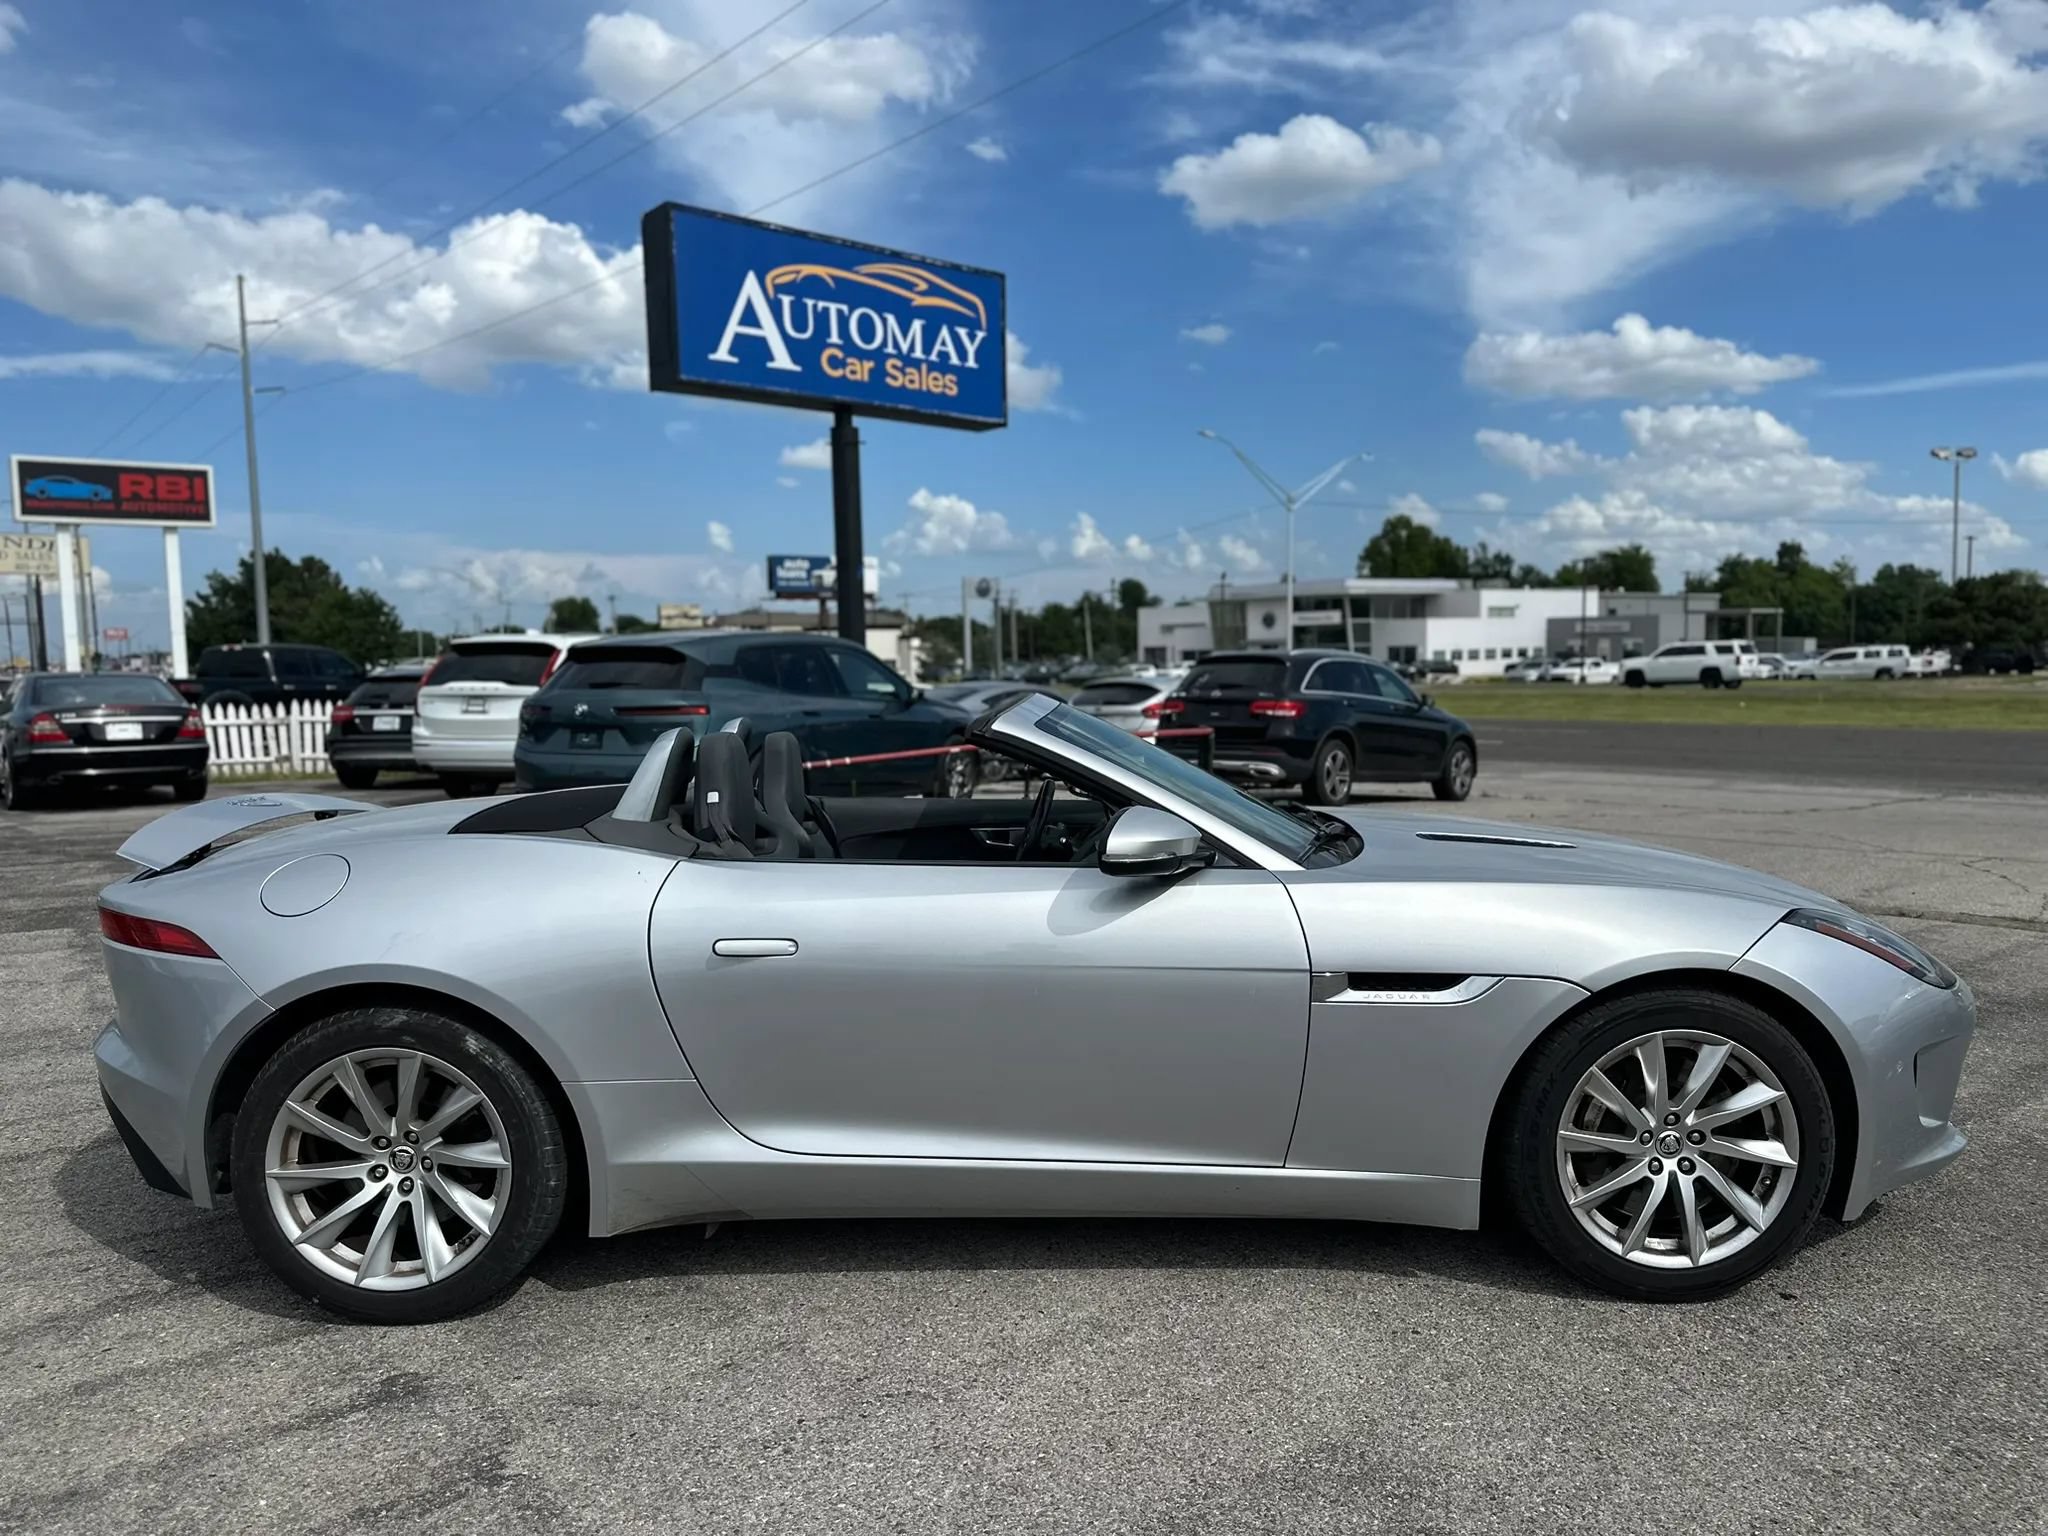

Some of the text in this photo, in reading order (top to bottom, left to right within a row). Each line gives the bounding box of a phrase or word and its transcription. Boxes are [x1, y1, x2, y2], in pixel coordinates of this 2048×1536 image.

[707, 269, 988, 371] AUTOMAY
[820, 347, 958, 398] Car Sales
[118, 472, 206, 502] RBI
[120, 501, 206, 514] AUTOMOTIVE
